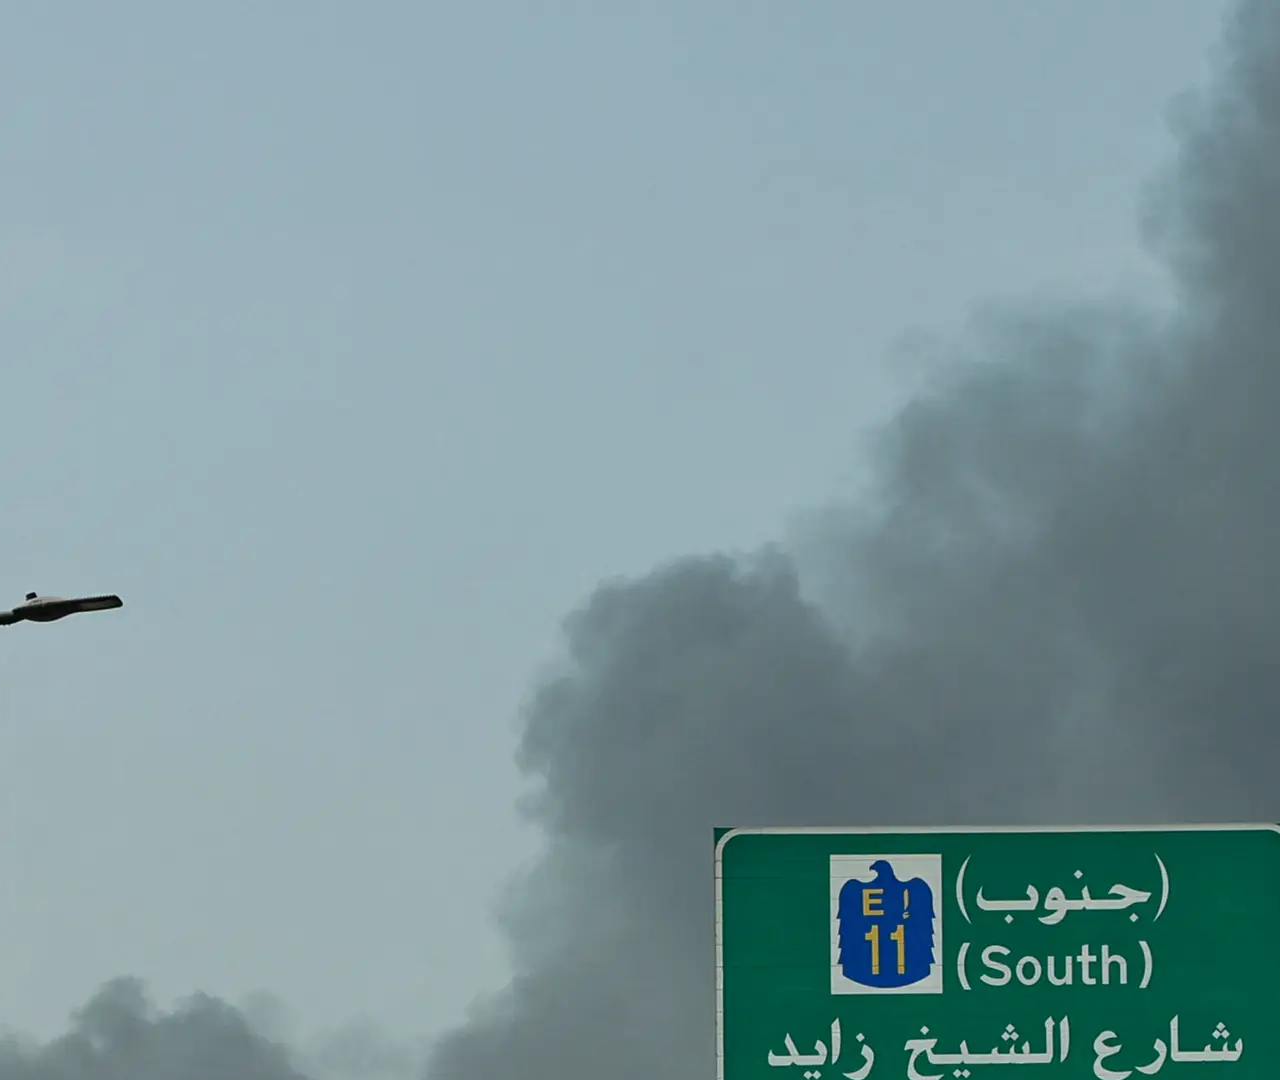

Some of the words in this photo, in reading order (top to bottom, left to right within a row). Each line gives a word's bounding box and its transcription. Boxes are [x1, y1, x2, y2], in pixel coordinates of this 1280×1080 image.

[862, 888, 885, 916] E
[956, 854, 1169, 924] (جنوب)
[864, 924, 906, 975] 11
[957, 940, 1153, 991] (South)
[767, 1017, 875, 1080] زايد
